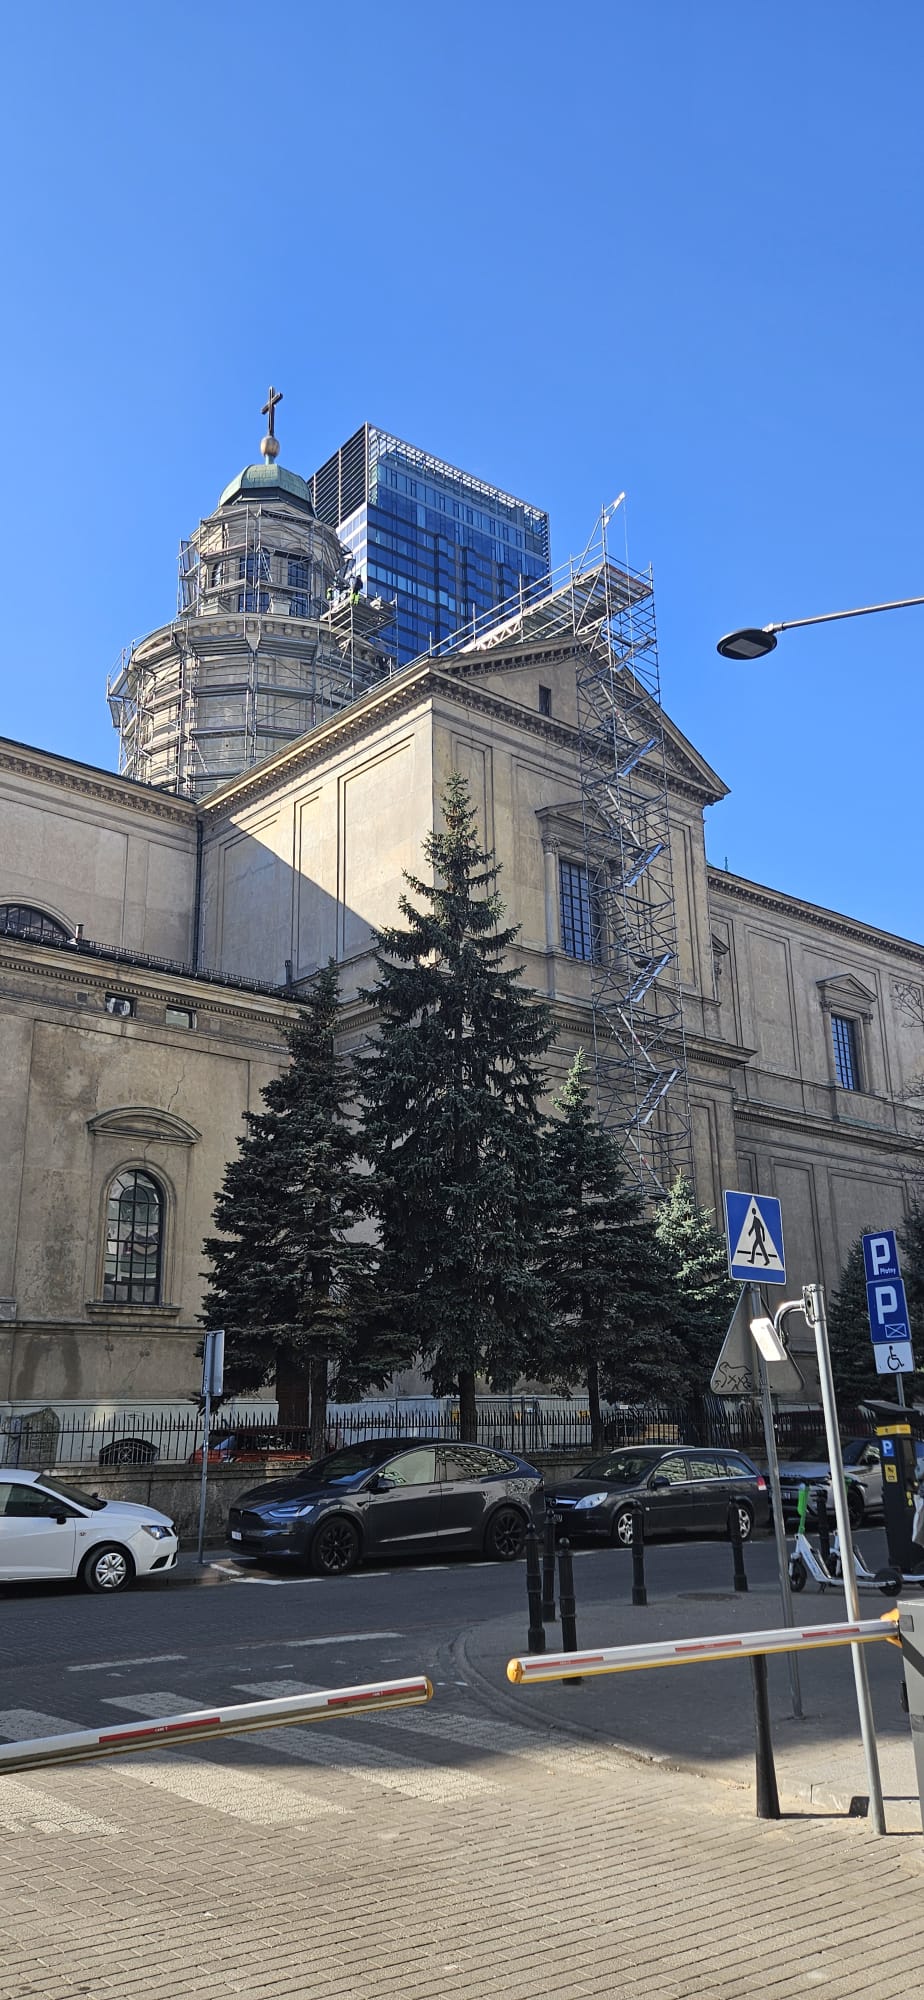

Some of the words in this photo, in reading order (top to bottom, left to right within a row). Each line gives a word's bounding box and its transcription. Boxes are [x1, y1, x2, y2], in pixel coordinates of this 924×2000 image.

[870, 1237, 891, 1275] P
[875, 1285, 898, 1324] P
[882, 1440, 892, 1454] P
